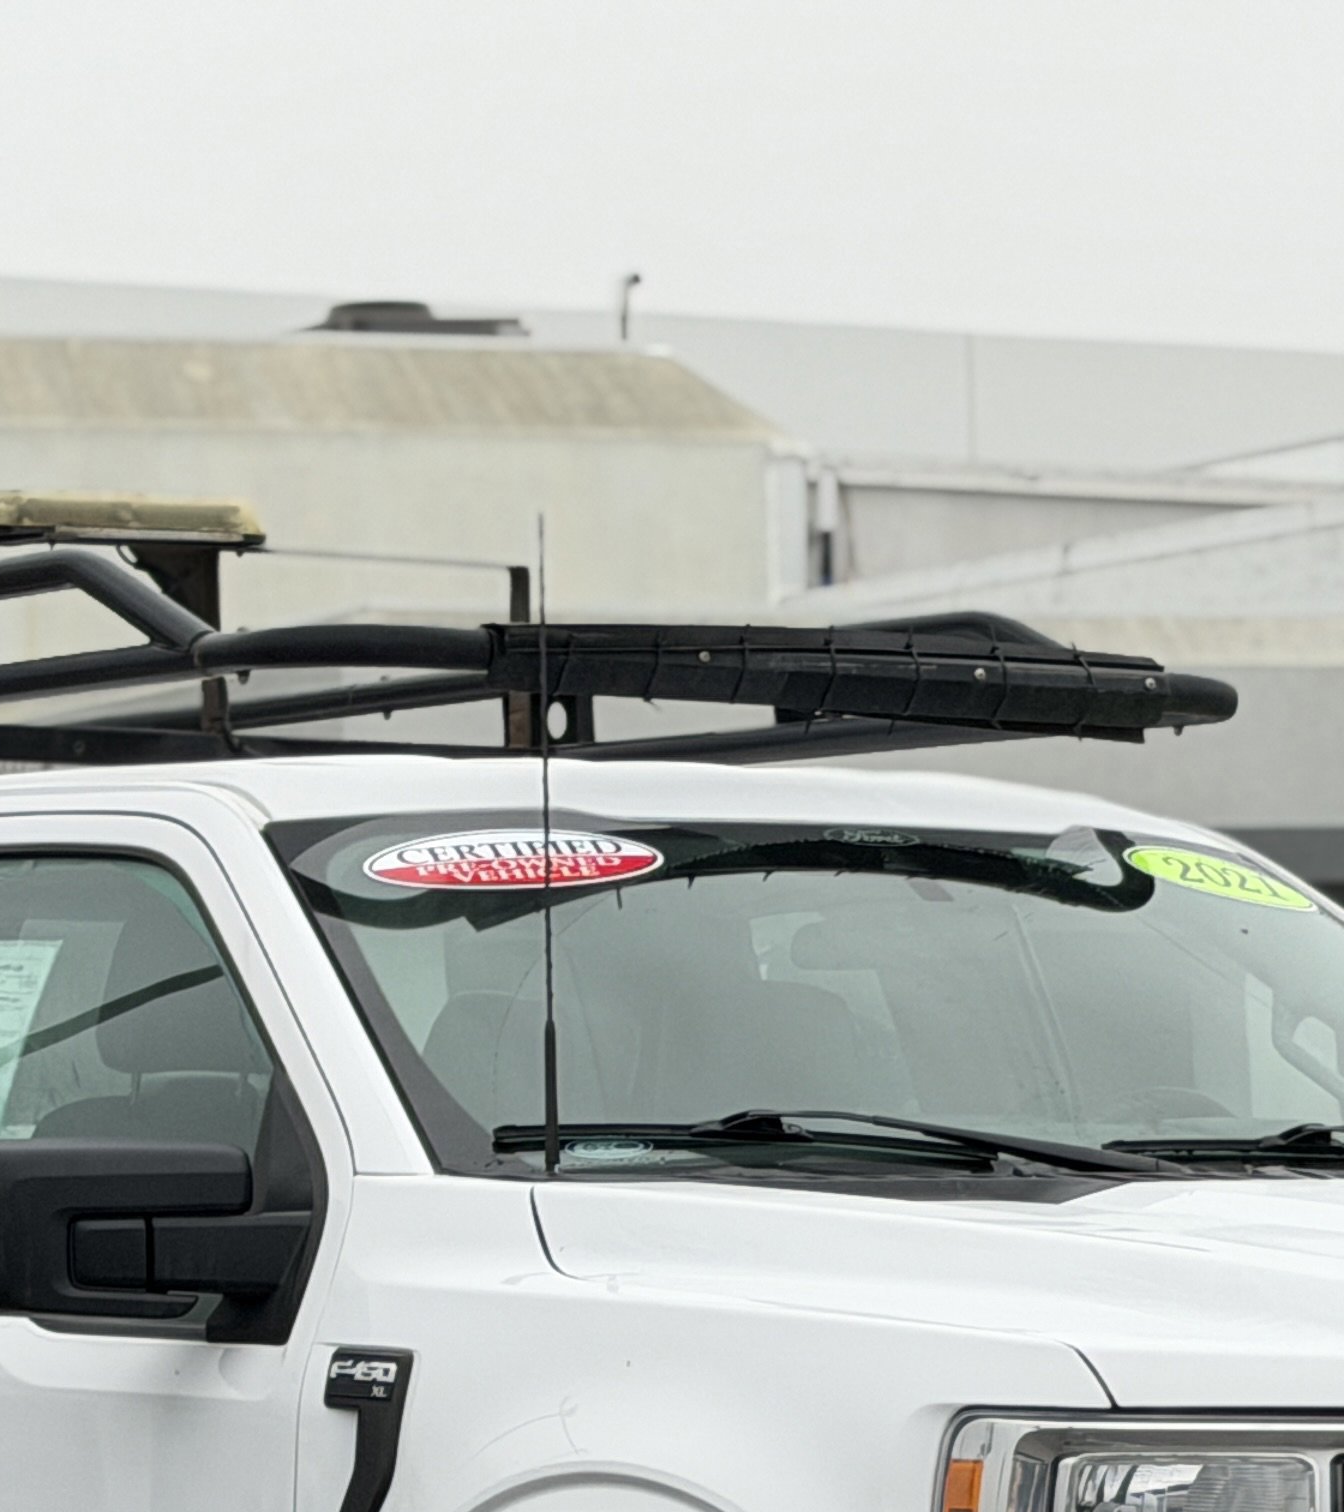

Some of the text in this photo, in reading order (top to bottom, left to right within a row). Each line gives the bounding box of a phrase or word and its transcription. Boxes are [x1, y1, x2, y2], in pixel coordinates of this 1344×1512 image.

[397, 841, 621, 865] CERTIFIED
[415, 856, 622, 876] PRE-OWNED
[453, 865, 601, 883] VEHICLE
[1162, 856, 1288, 901] 2021
